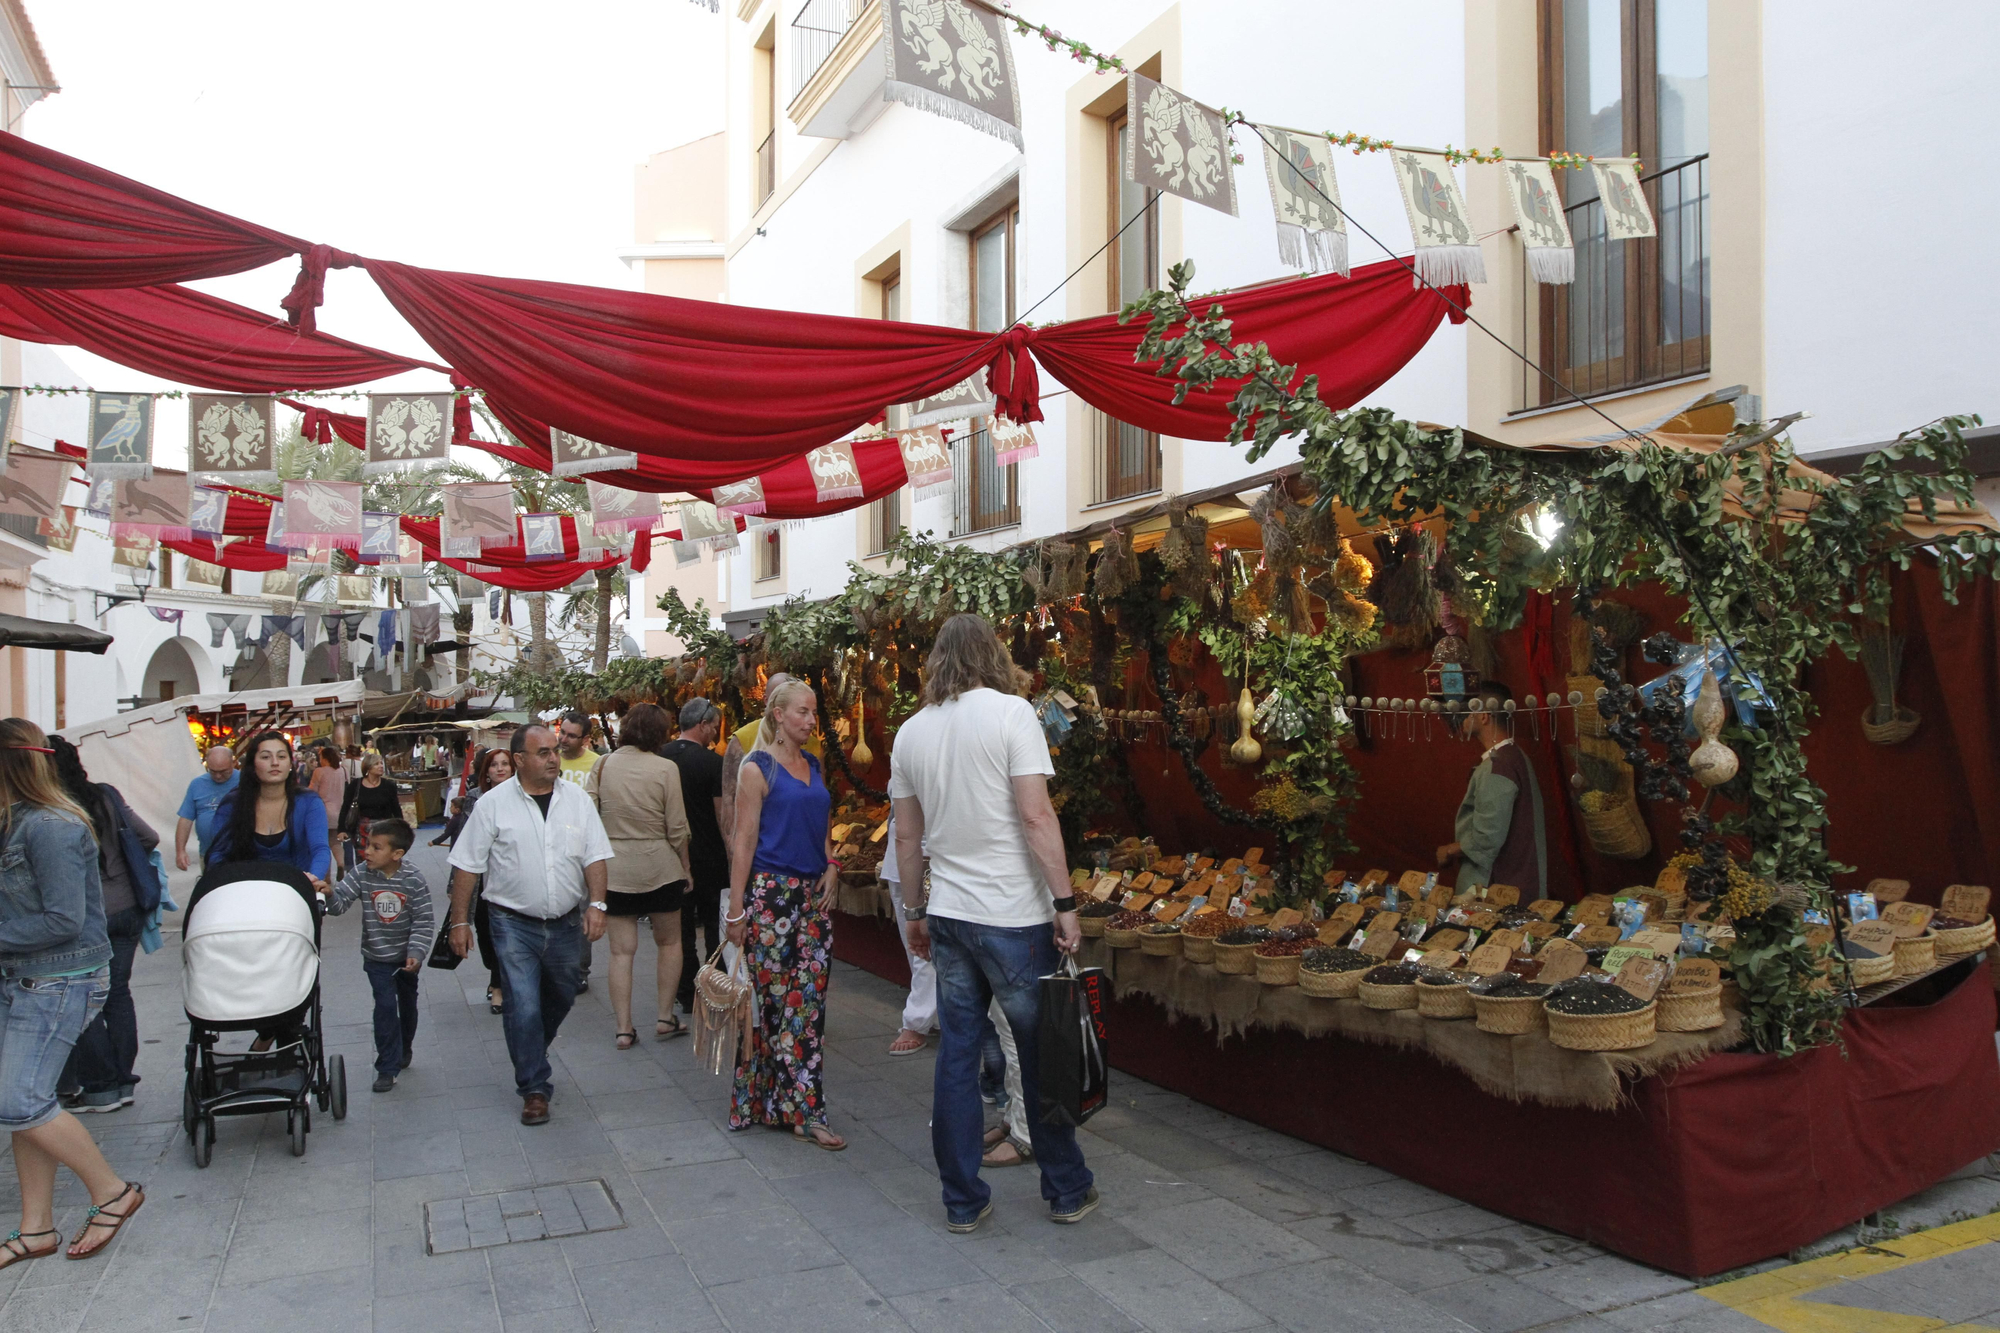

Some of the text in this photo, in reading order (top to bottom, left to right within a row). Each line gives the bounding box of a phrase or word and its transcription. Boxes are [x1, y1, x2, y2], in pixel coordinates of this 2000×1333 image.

[377, 902, 398, 913] FUEL
[1641, 934, 1663, 944] TE
[1606, 958, 1624, 968] REL
[1086, 975, 1107, 1040] REPLAY
